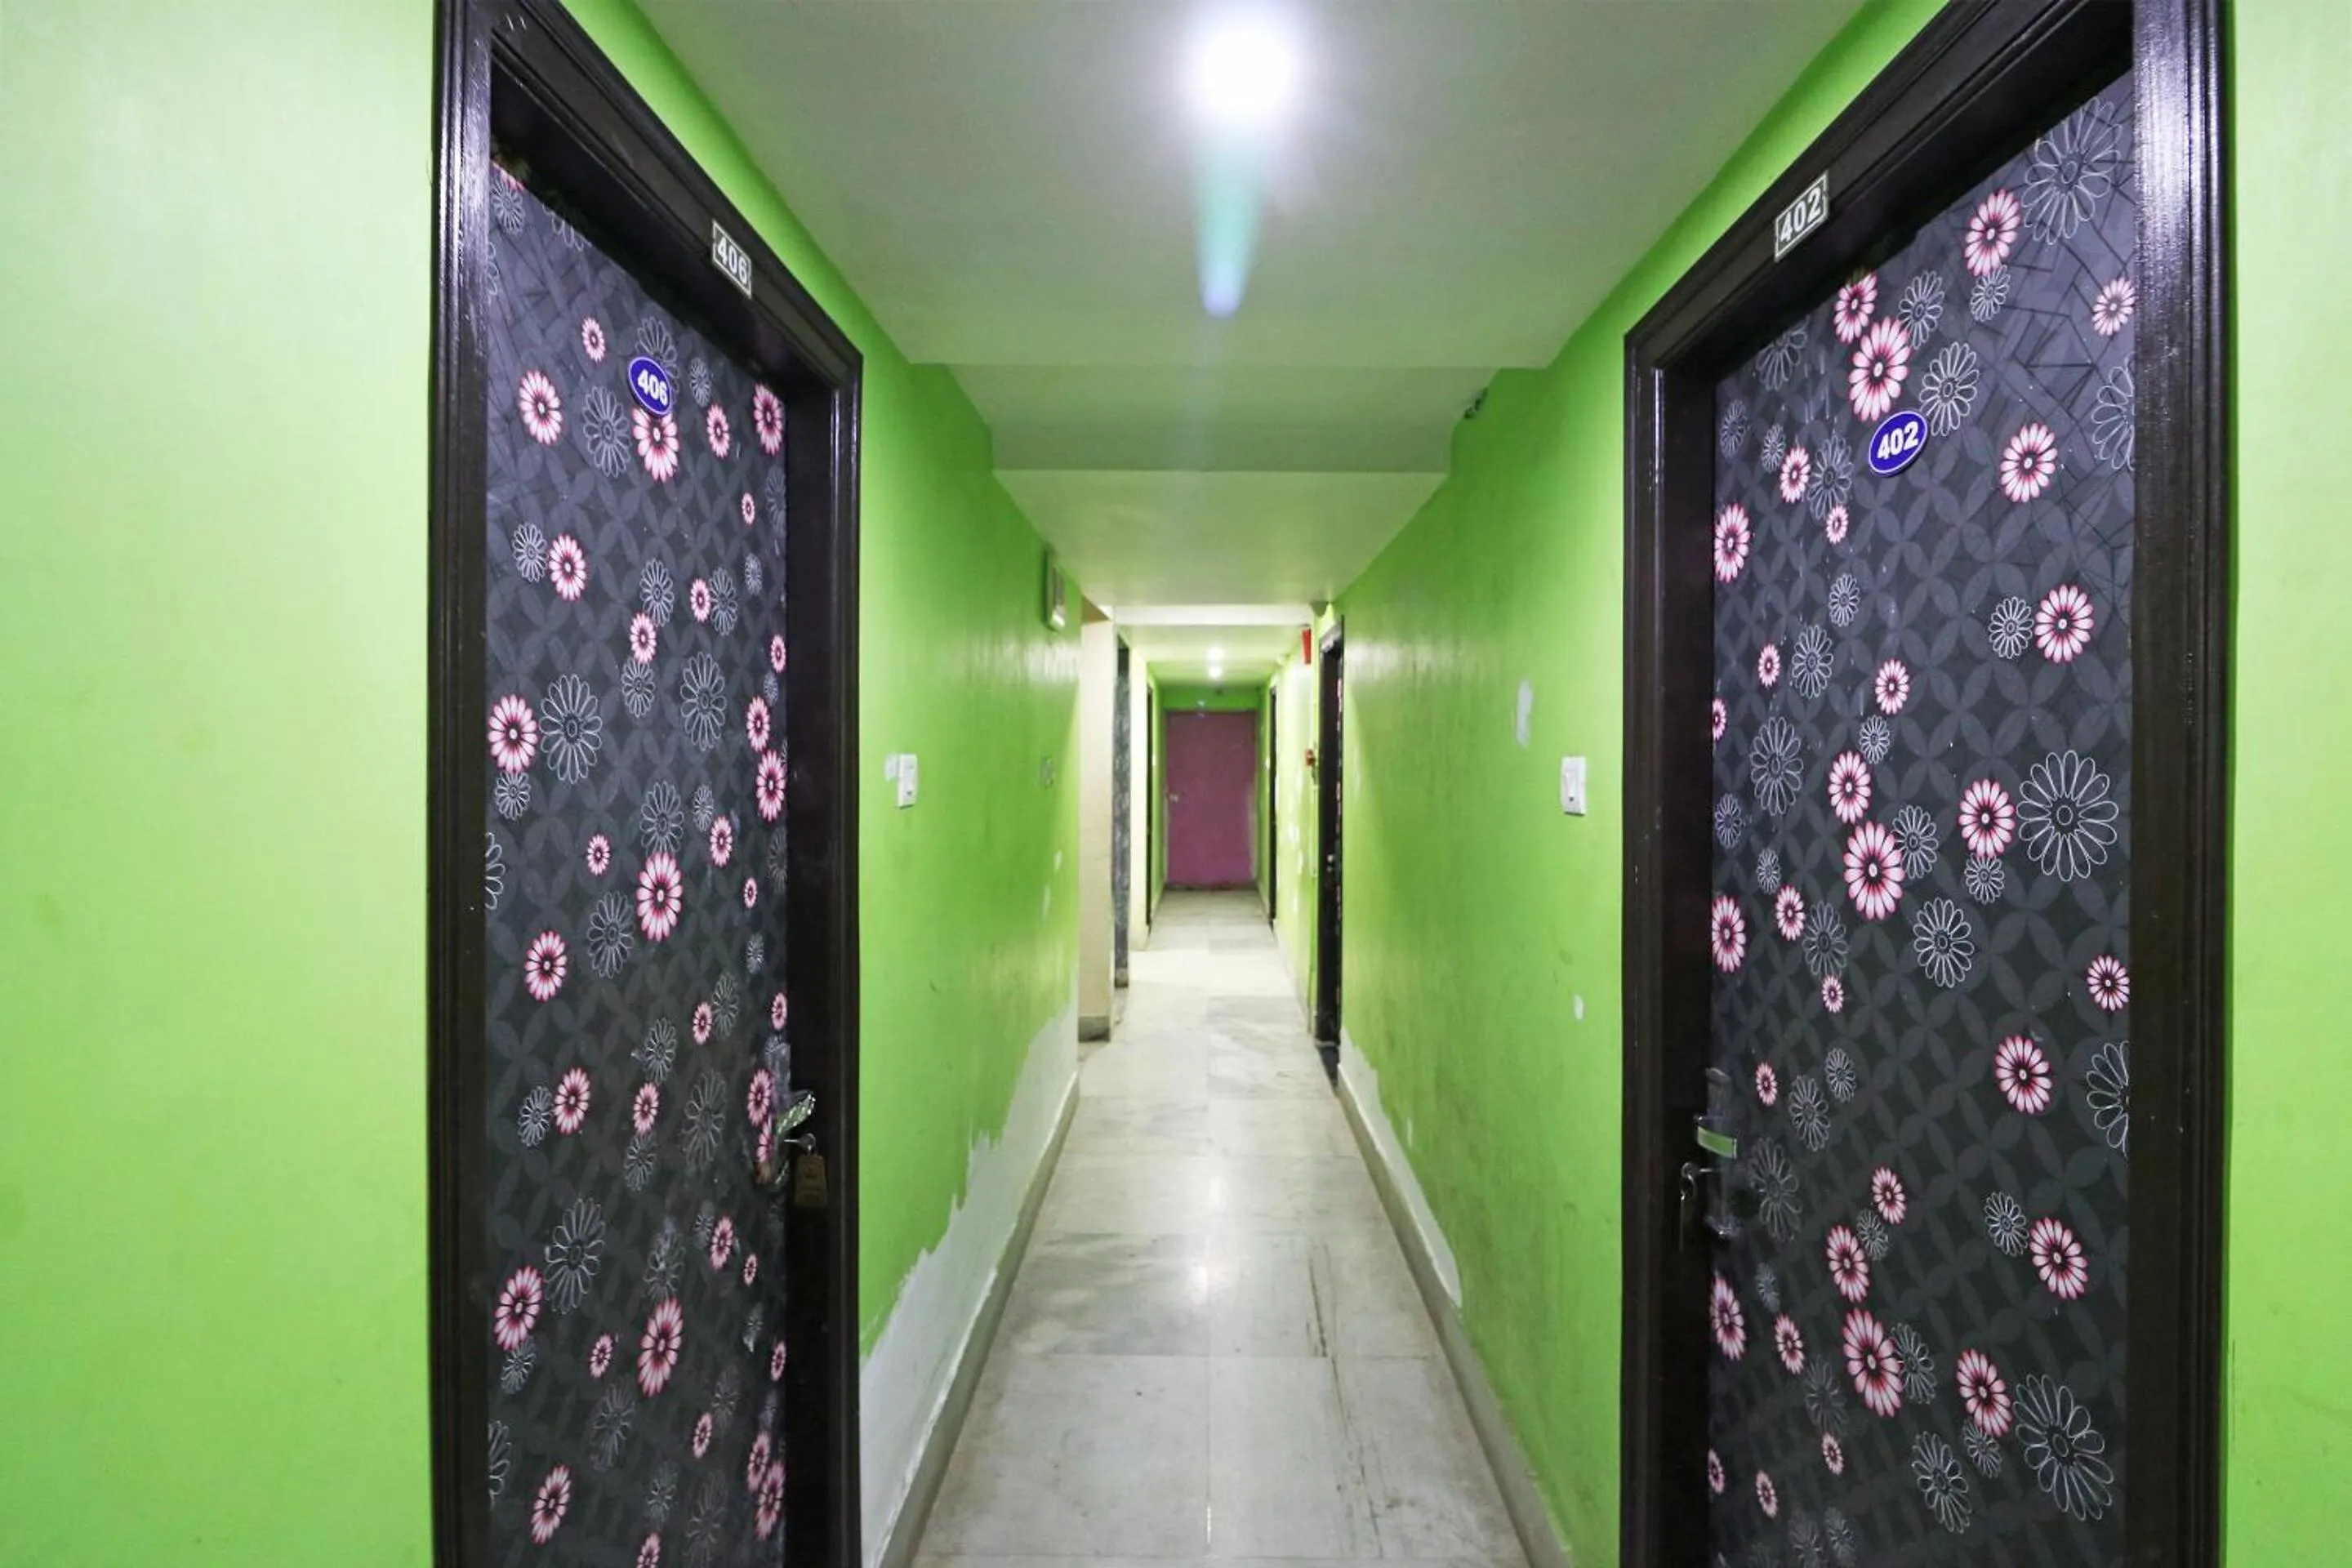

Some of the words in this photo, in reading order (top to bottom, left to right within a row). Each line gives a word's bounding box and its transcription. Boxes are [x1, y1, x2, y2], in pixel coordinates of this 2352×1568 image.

[1780, 187, 1821, 243] 402
[717, 237, 747, 284] 406
[638, 369, 668, 406] 406
[1877, 421, 1918, 460] 402
